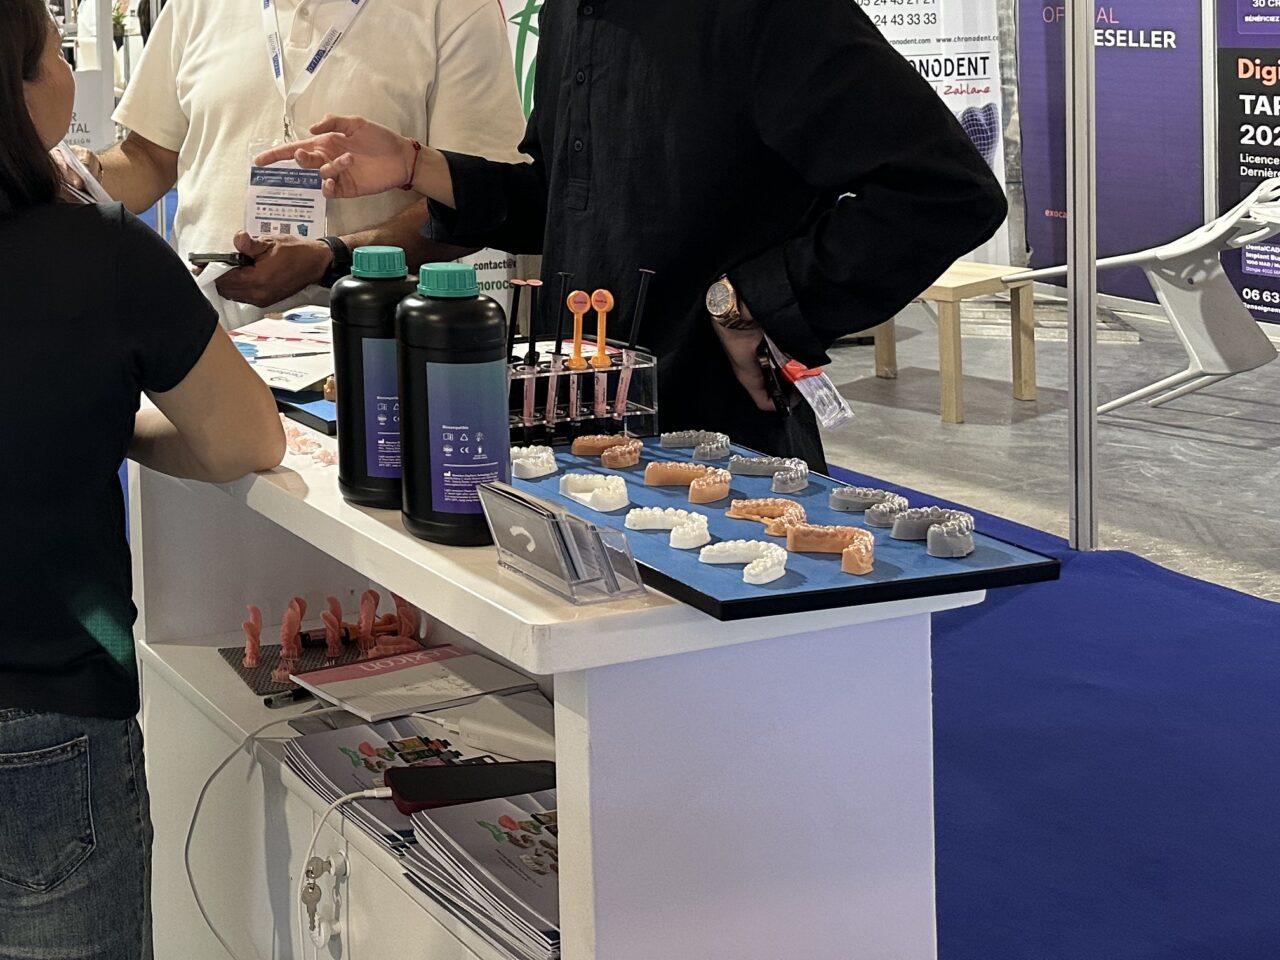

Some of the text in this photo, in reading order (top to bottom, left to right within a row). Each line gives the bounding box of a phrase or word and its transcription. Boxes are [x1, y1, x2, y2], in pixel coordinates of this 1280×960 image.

[874, 13, 937, 26] 24 43 33 33
[1094, 28, 1177, 49] ESELLER
[1045, 208, 1067, 218] exoca
[1242, 287, 1280, 304] 06 63
